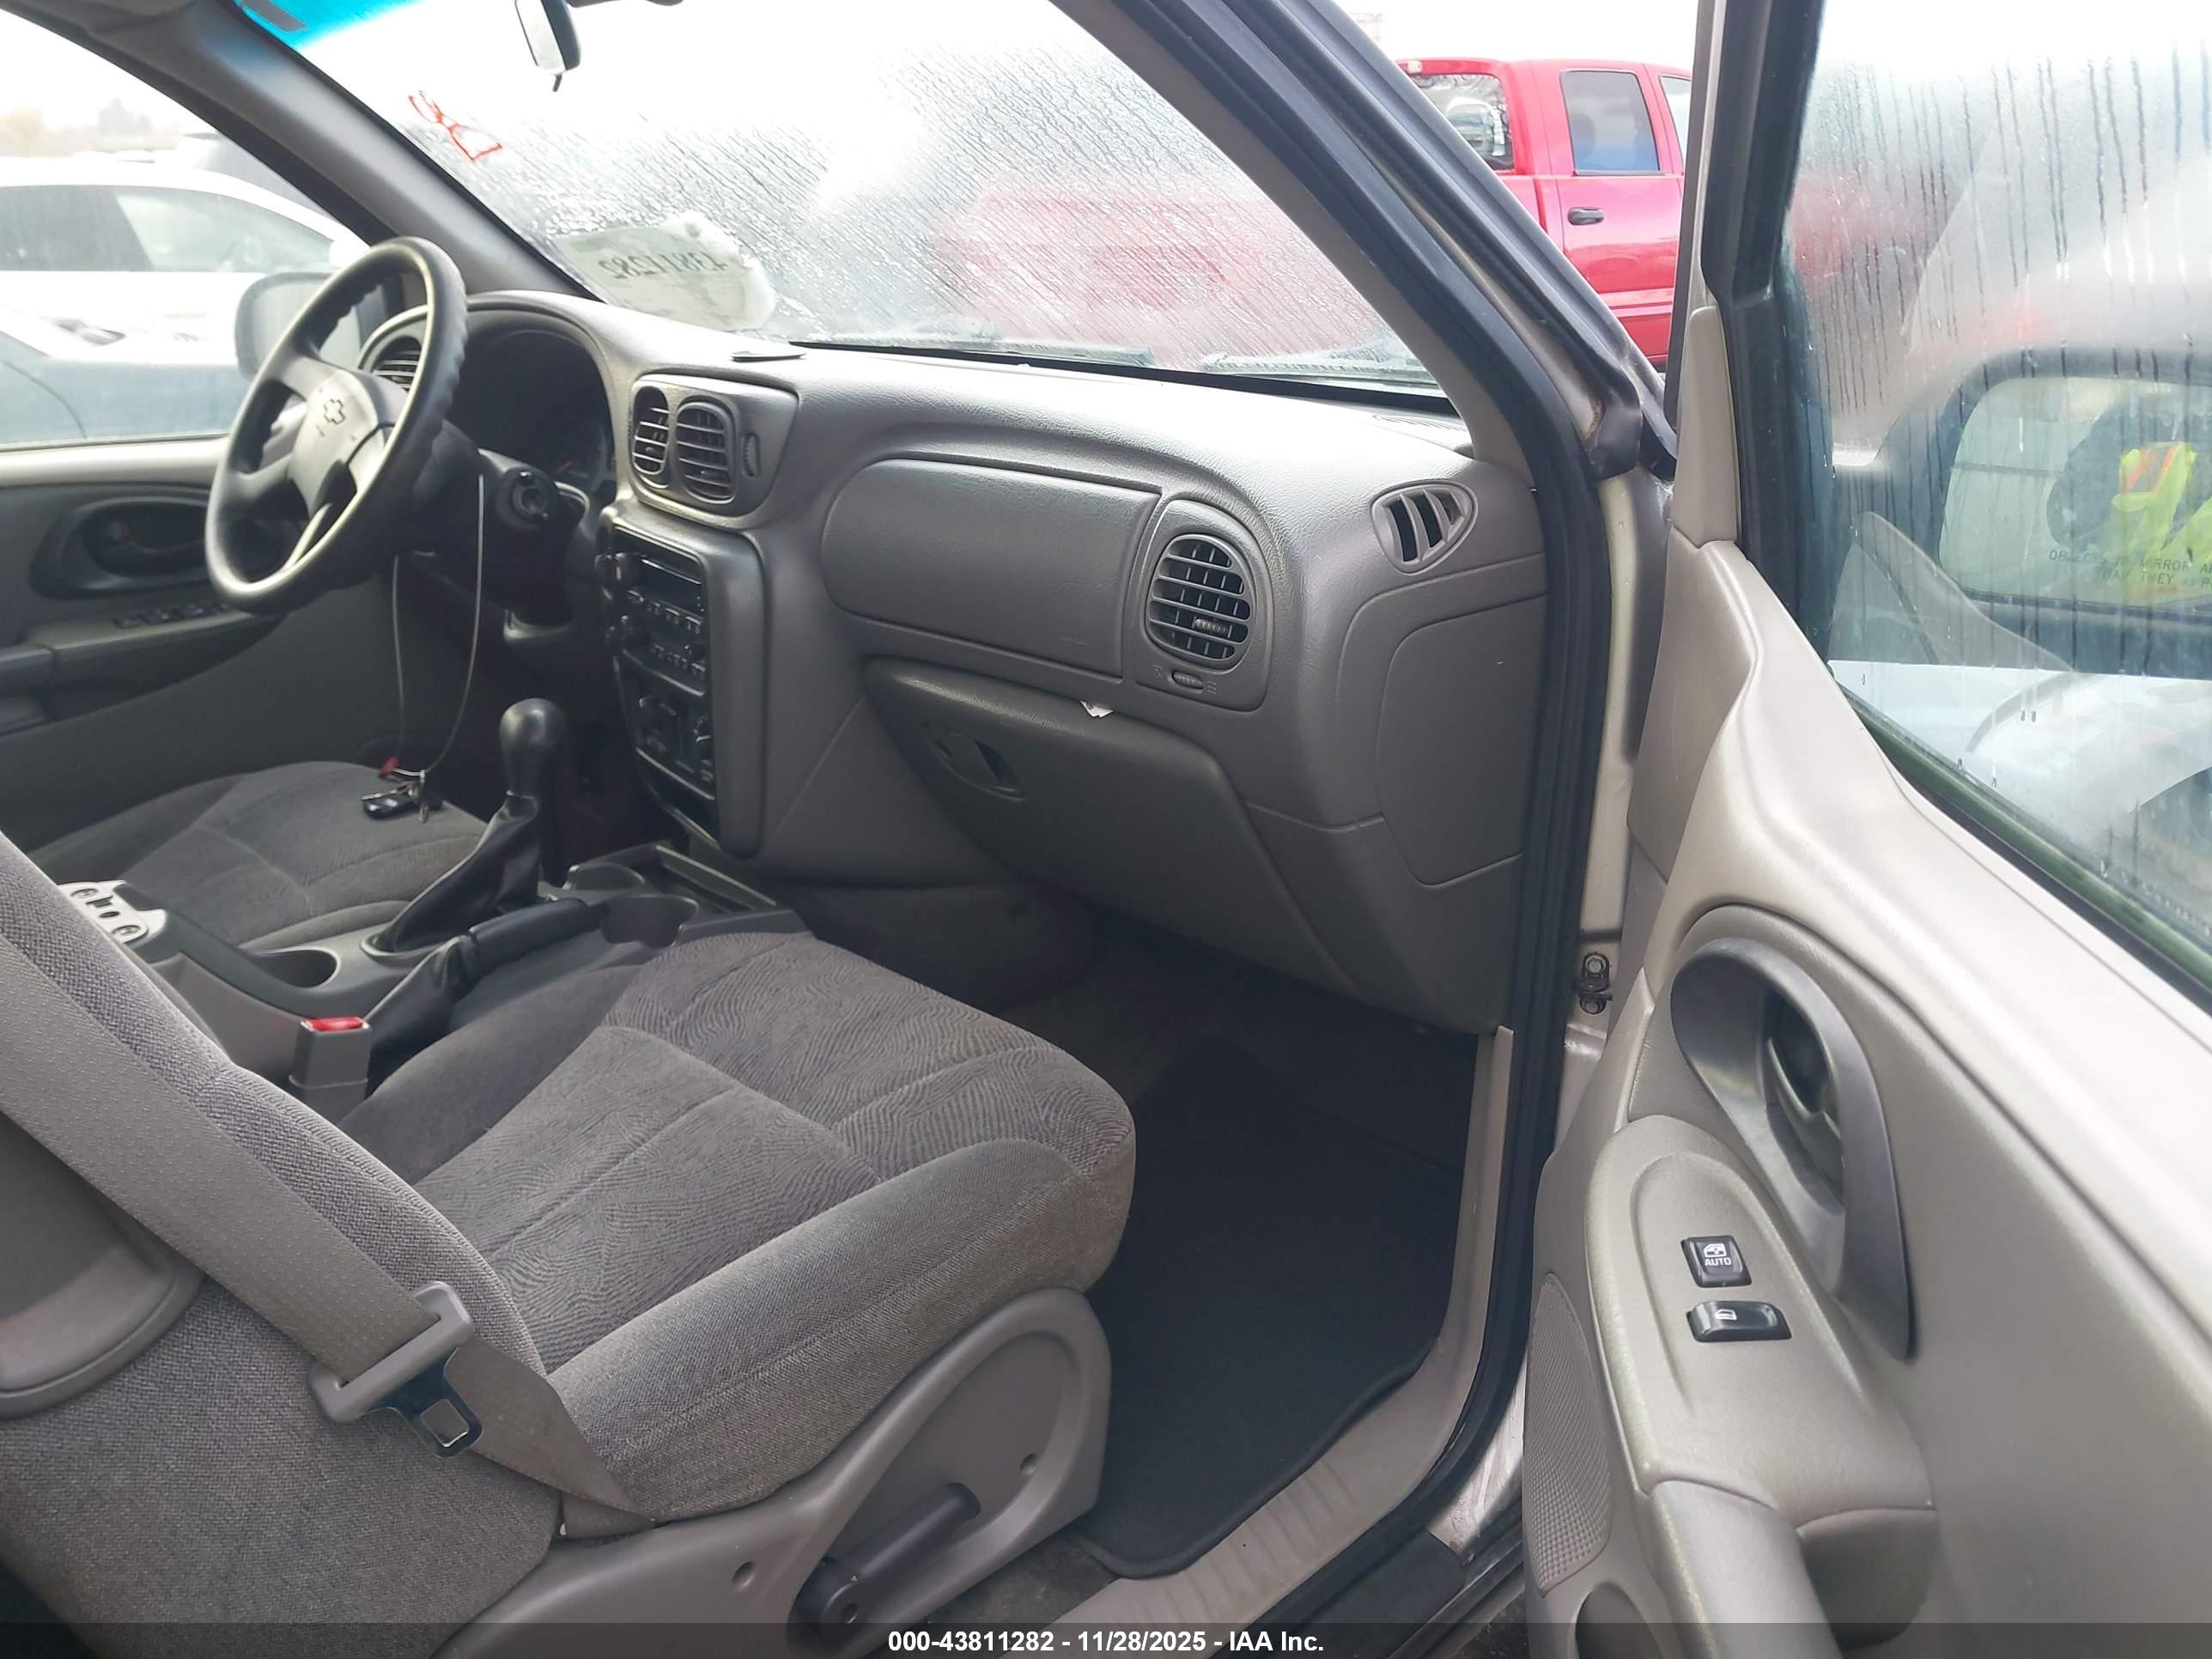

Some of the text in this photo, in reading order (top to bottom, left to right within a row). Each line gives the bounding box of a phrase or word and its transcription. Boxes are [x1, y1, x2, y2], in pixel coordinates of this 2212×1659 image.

[2049, 550, 2109, 563] OBECS
[2139, 556, 2191, 571] MRROR
[1705, 1257, 1732, 1266] AUTO
